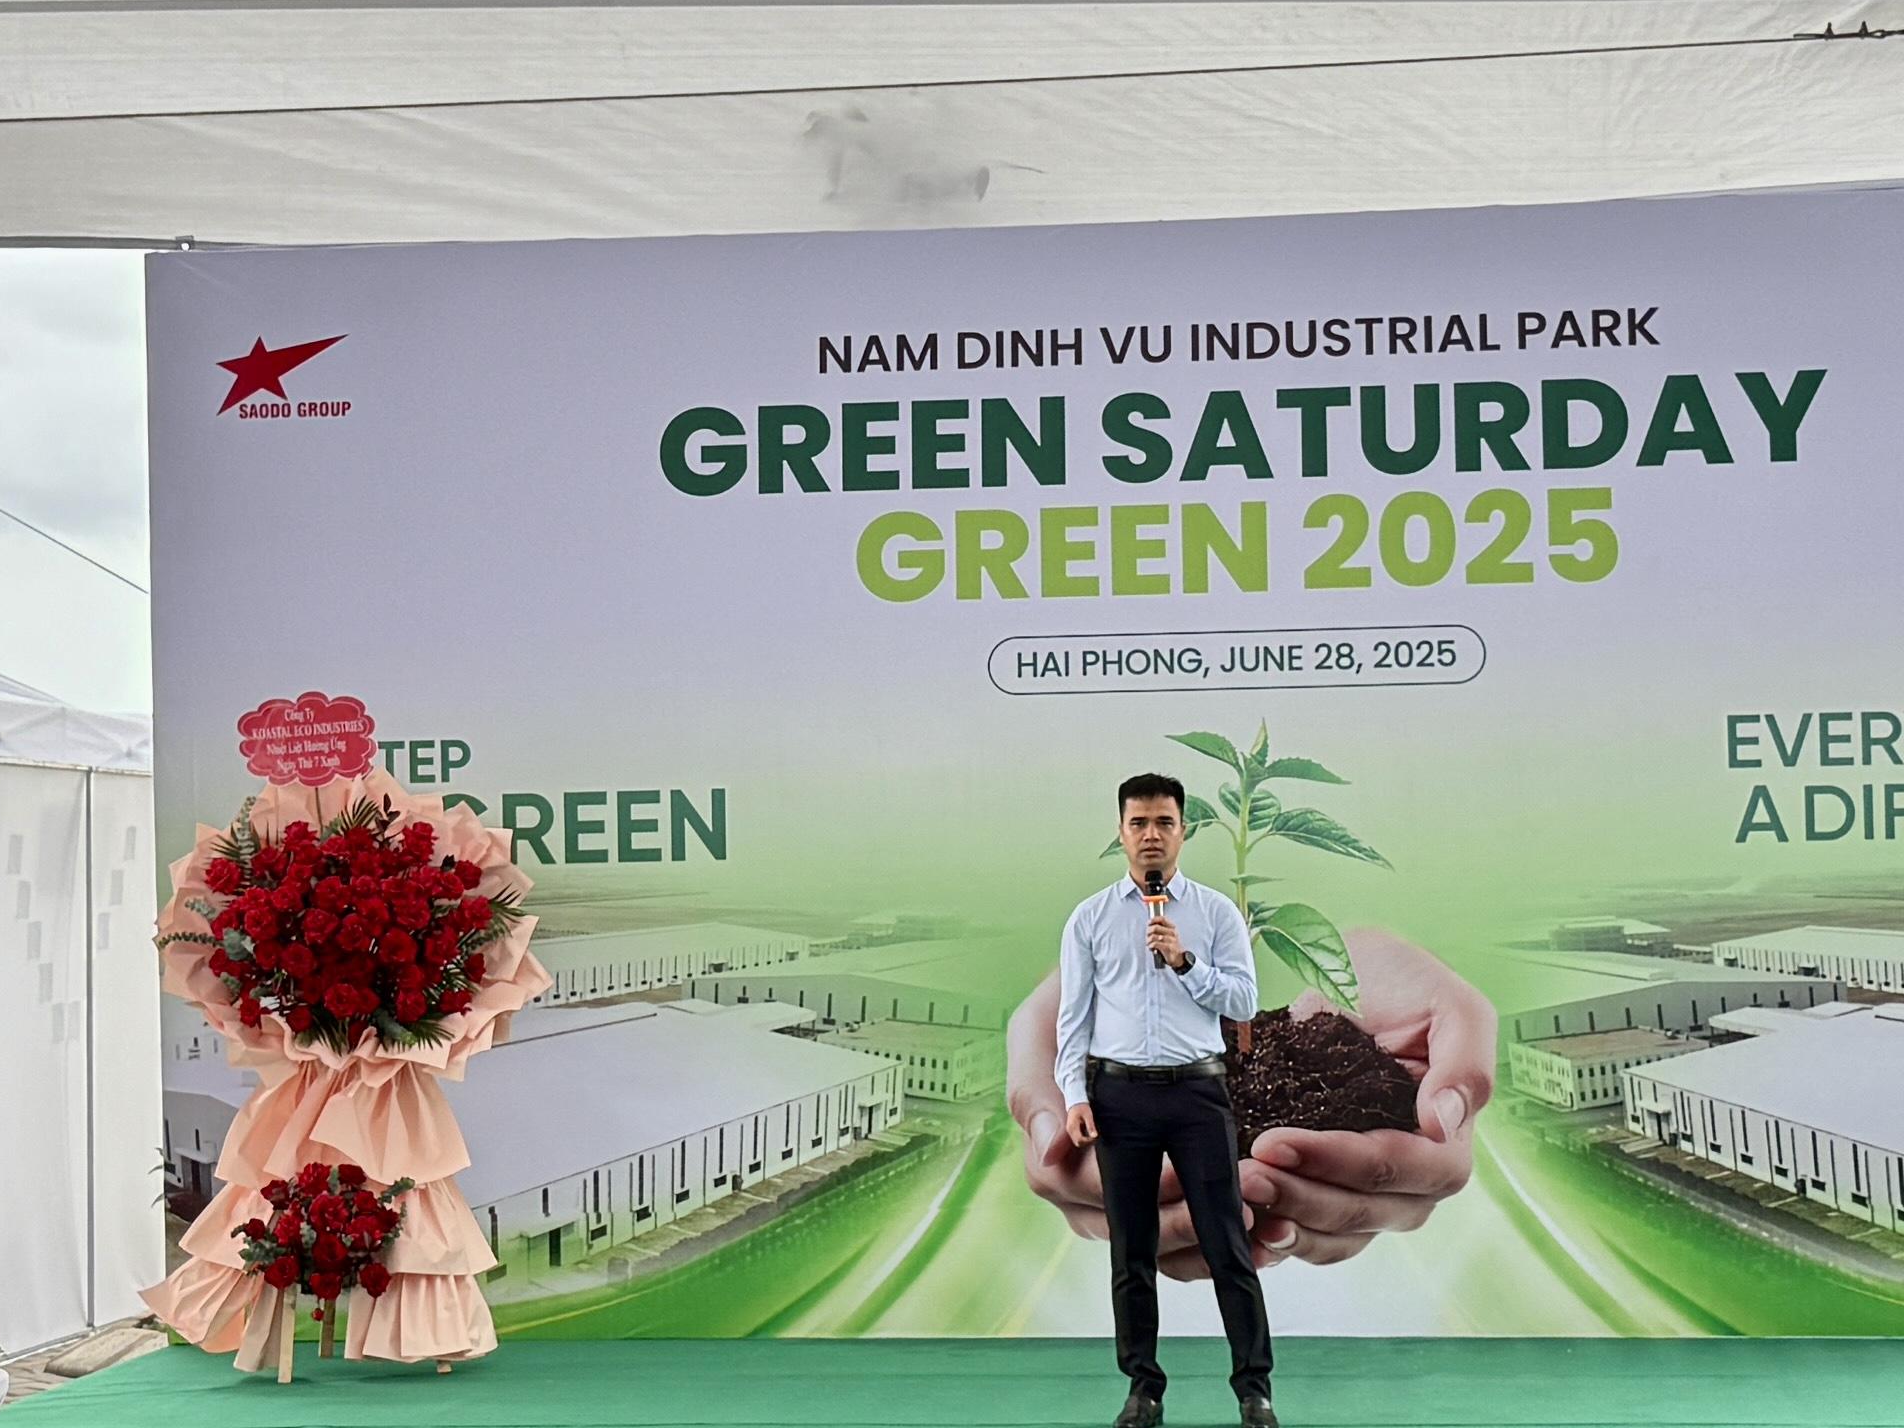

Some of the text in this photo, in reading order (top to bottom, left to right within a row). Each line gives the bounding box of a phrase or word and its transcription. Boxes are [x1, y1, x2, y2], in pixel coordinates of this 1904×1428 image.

[818, 306, 1661, 374] NAM DINH VU INDUSTRIAL PARK
[239, 401, 352, 420] SAODO GROUP
[659, 368, 1829, 497] GREEN SATURDAY
[856, 486, 1620, 603] GREEN 2025
[1016, 639, 1457, 679] HAI PHONG, JUNE 28, 2025
[294, 724, 313, 736] ECO
[313, 720, 365, 735] INDUSTRIES
[442, 787, 728, 866] REEN
[1735, 784, 1790, 844] A
